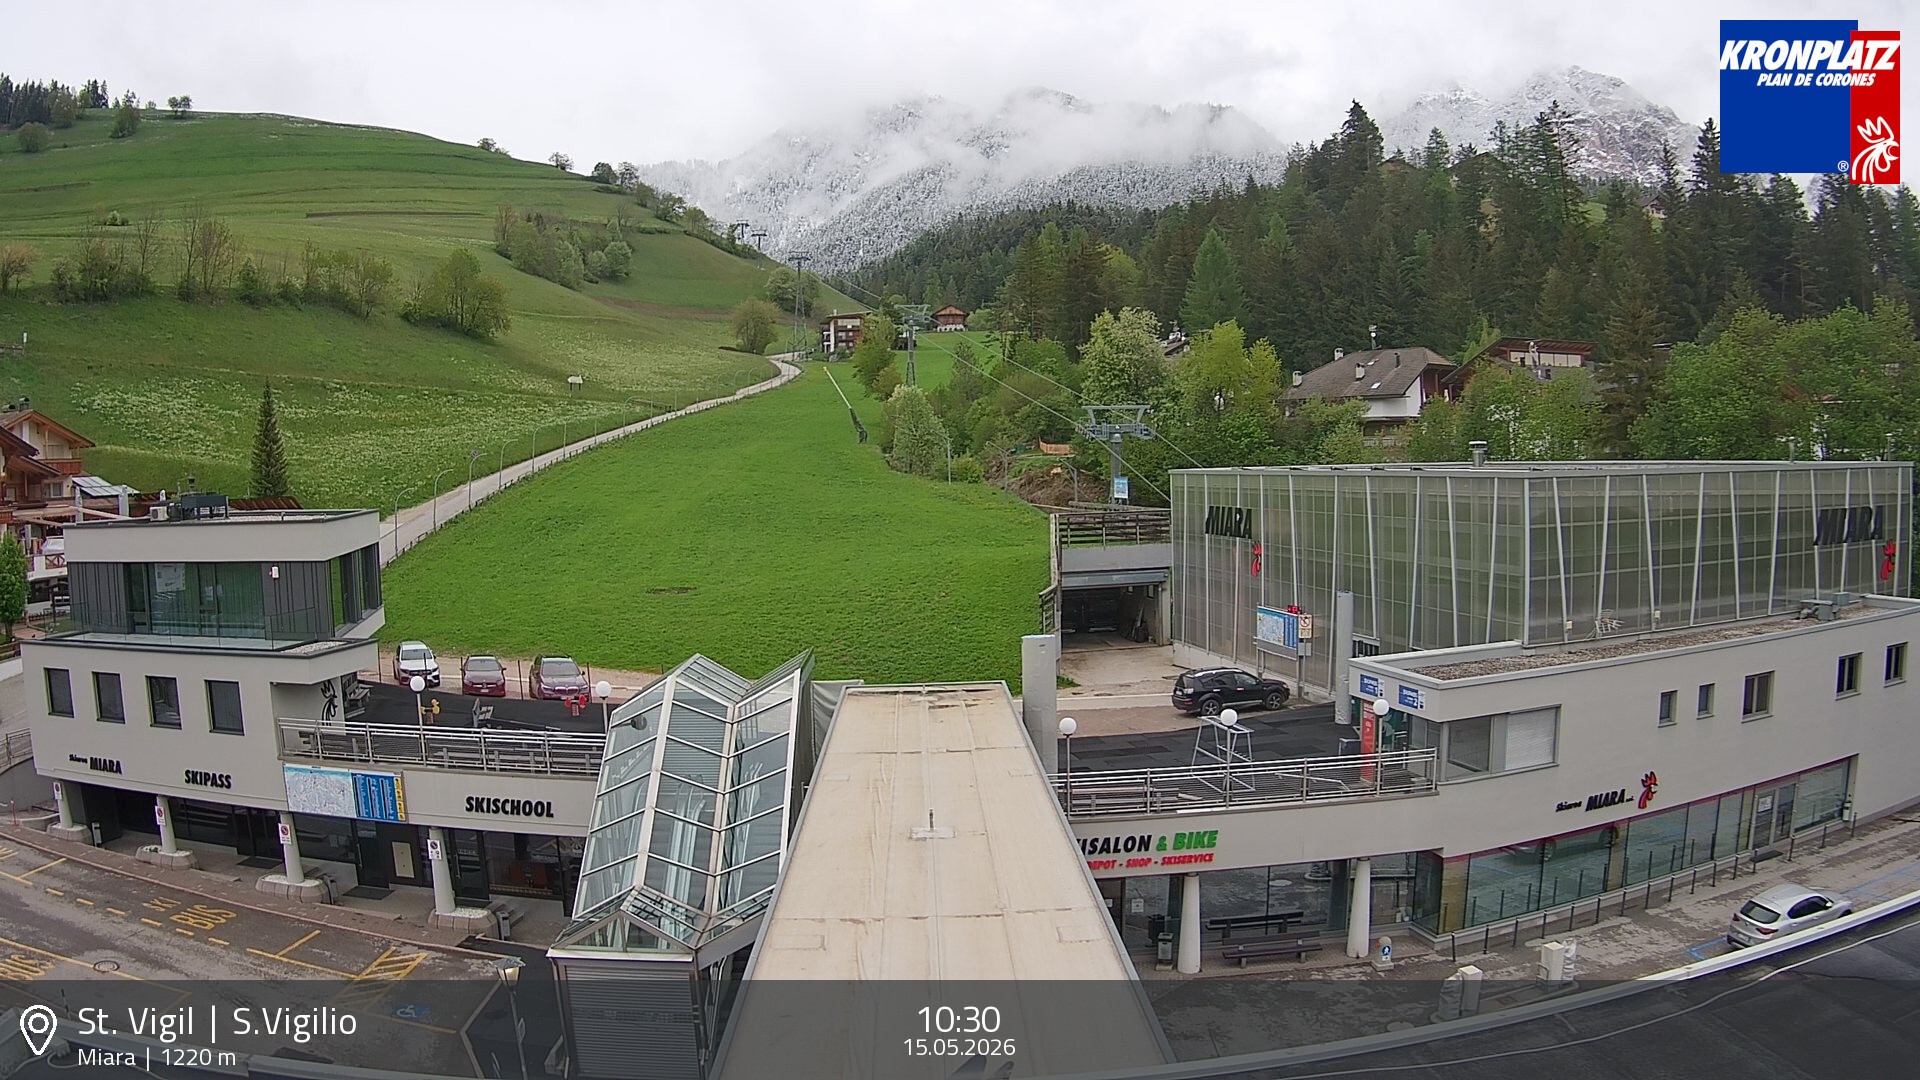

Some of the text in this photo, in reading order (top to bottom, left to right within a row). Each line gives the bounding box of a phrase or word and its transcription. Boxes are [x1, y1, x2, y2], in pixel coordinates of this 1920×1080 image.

[1205, 505, 1253, 539] MIARA
[1813, 505, 1884, 546] MIARA
[90, 756, 122, 774] MIARA
[184, 769, 232, 789] SKIPASS
[465, 796, 554, 818] SKISCHOOL
[1585, 788, 1626, 812] MIARA
[1156, 836, 1167, 852] &
[1172, 830, 1219, 851] BIKE
[1125, 857, 1152, 869] SHOP
[1161, 853, 1214, 866] SKISERVICE
[169, 904, 237, 930] BUS
